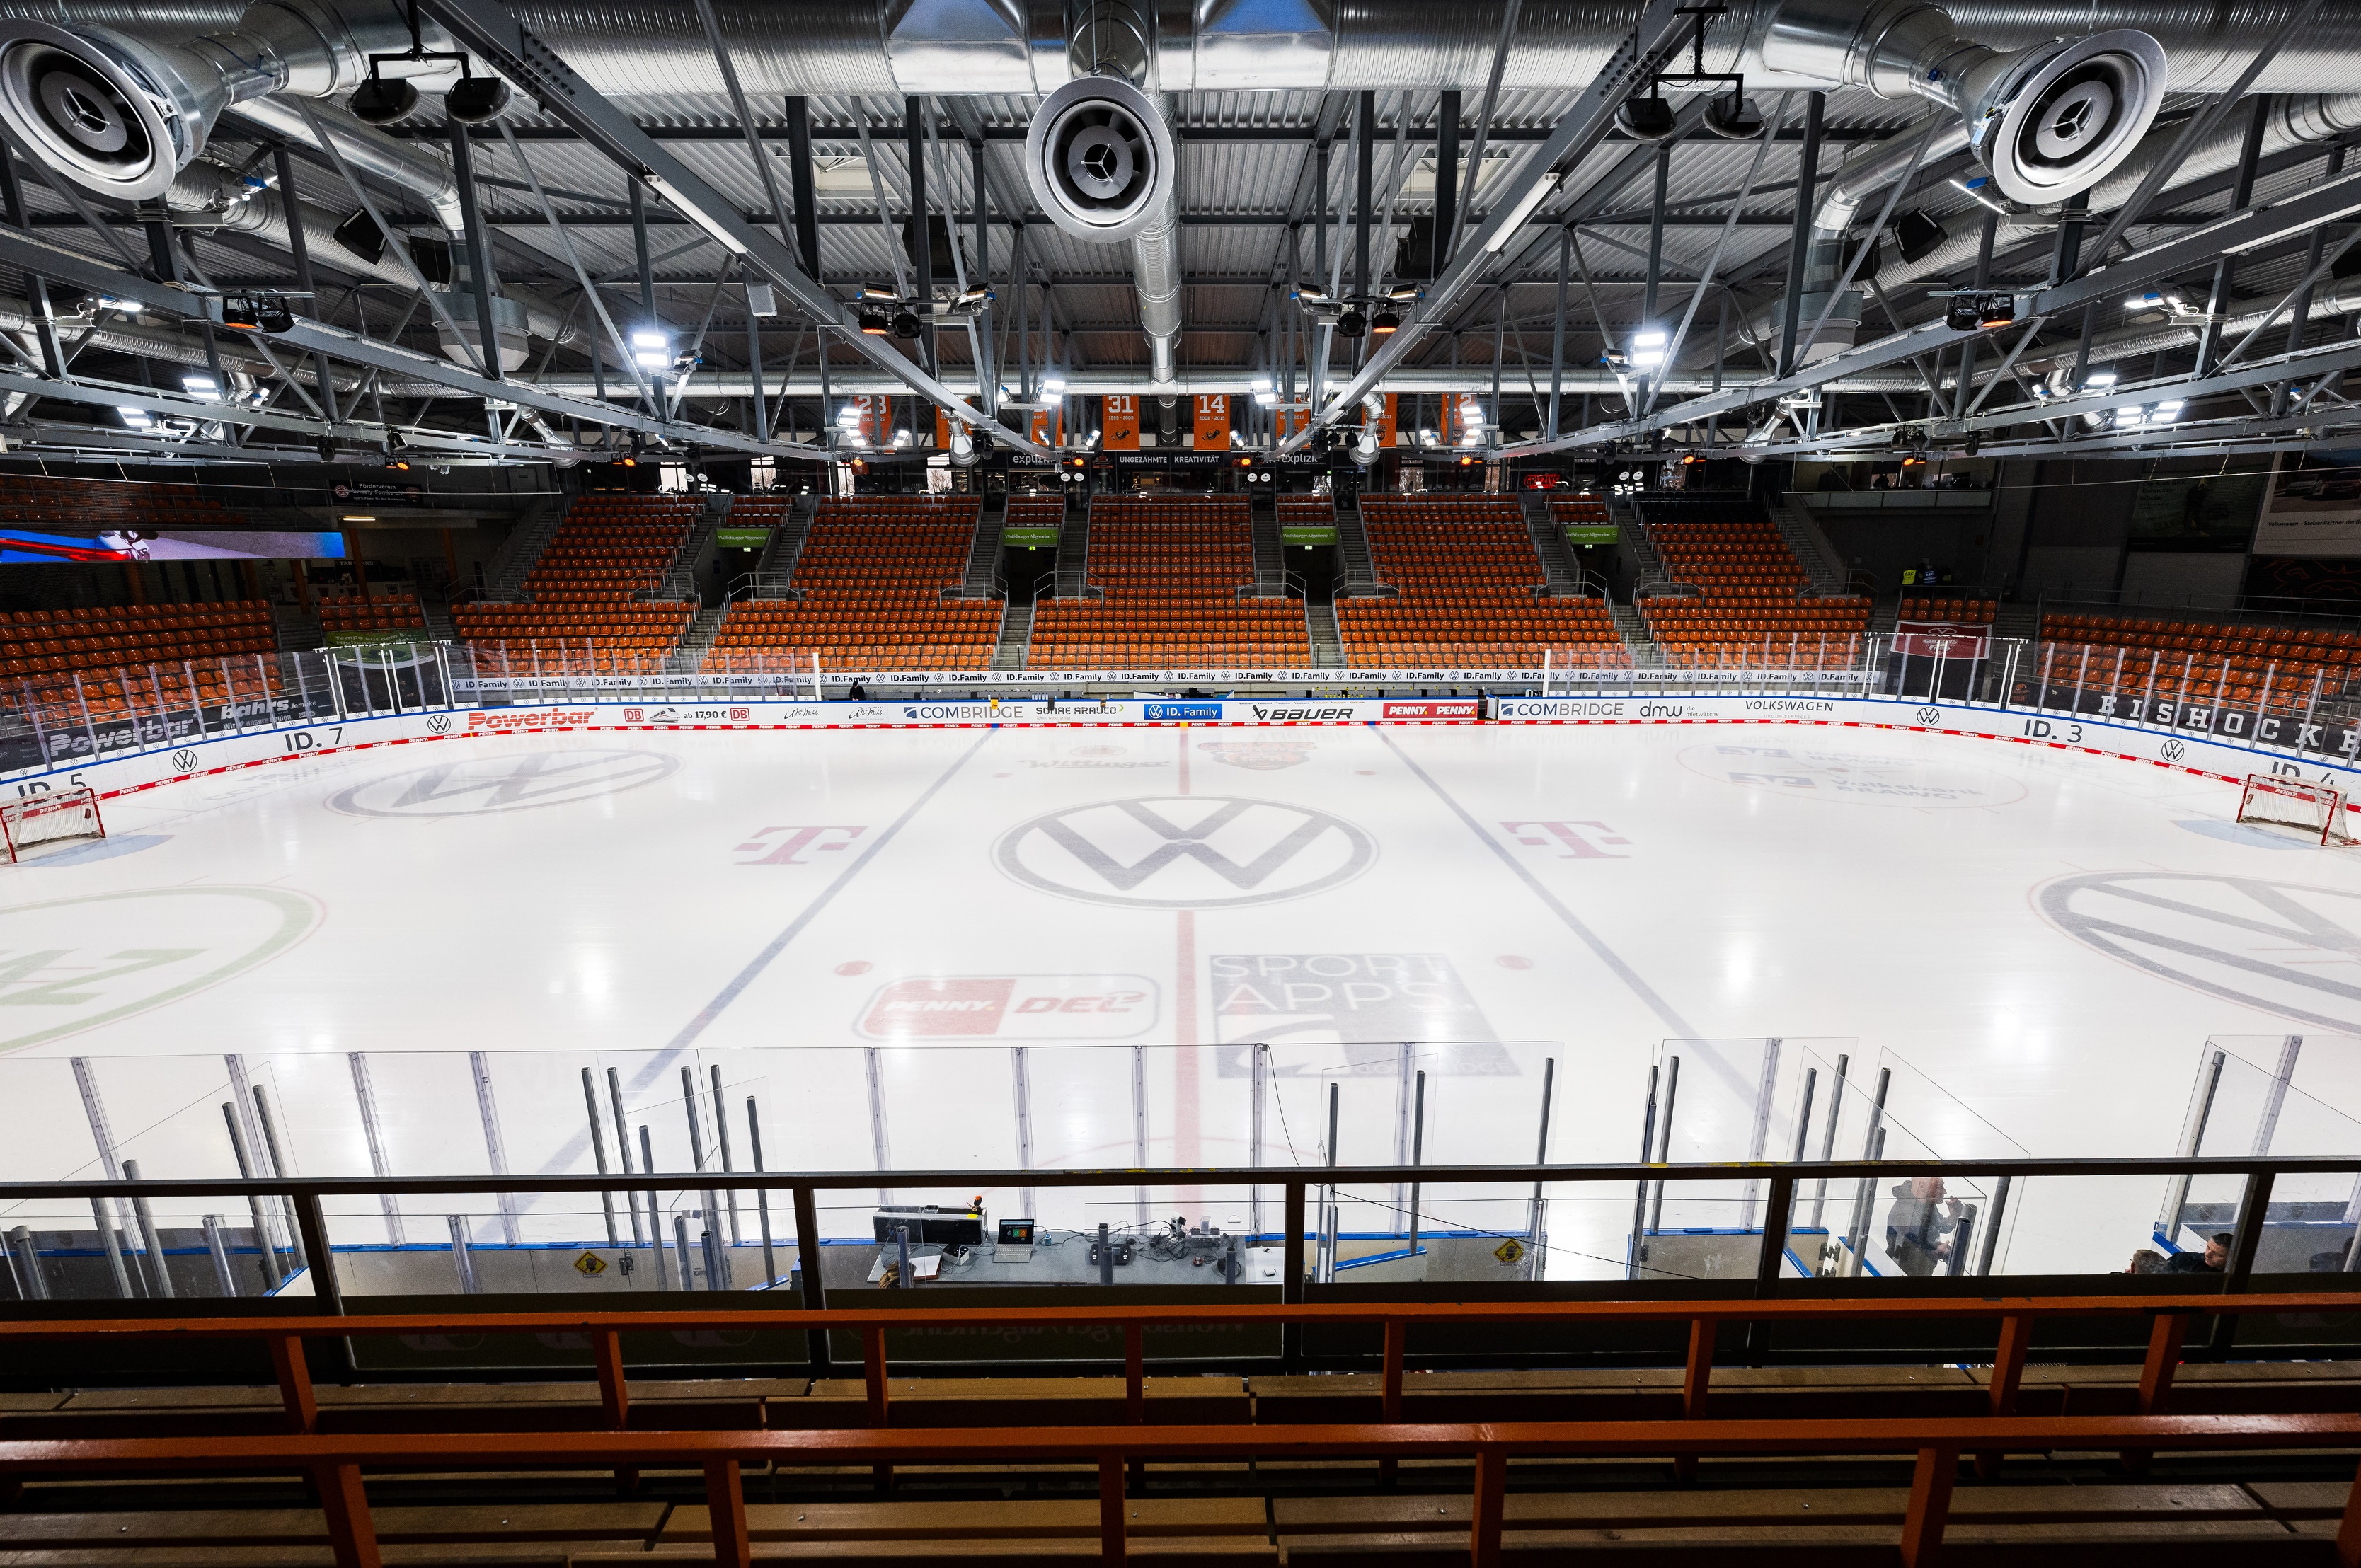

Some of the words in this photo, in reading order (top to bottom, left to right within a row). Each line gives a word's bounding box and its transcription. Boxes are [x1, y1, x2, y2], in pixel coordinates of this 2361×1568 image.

[1108, 395, 1134, 413] 31
[1199, 395, 1225, 413] 14
[1174, 455, 1219, 463] KREATIVITÄT
[890, 674, 929, 684] ID.Family
[949, 674, 987, 684] ID.Family
[1006, 673, 1045, 683] ID.Family
[1064, 673, 1102, 682] ID.Family
[1121, 673, 1159, 681] ID.Family
[1178, 672, 1216, 681] ID.Family
[1235, 672, 1273, 681] ID.Family
[1292, 672, 1330, 681] ID.Family
[1349, 671, 1387, 681] ID.Family
[1406, 671, 1444, 681] ID.Family
[1464, 671, 1502, 681] ID.Family
[221, 699, 289, 720] bahrs
[290, 701, 316, 710] Jemke
[921, 706, 1023, 719] COMBRIDGE
[1166, 706, 1181, 717] ID.
[1184, 706, 1218, 718] Family
[1517, 703, 1624, 716] COMBRIDGE
[1745, 701, 1834, 712] VOLKSWAGEN
[626, 710, 643, 720] DB
[695, 710, 719, 720] 17,90
[720, 710, 728, 719] €
[732, 710, 749, 720] DB
[328, 727, 343, 745] 7
[2067, 725, 2083, 743] 3
